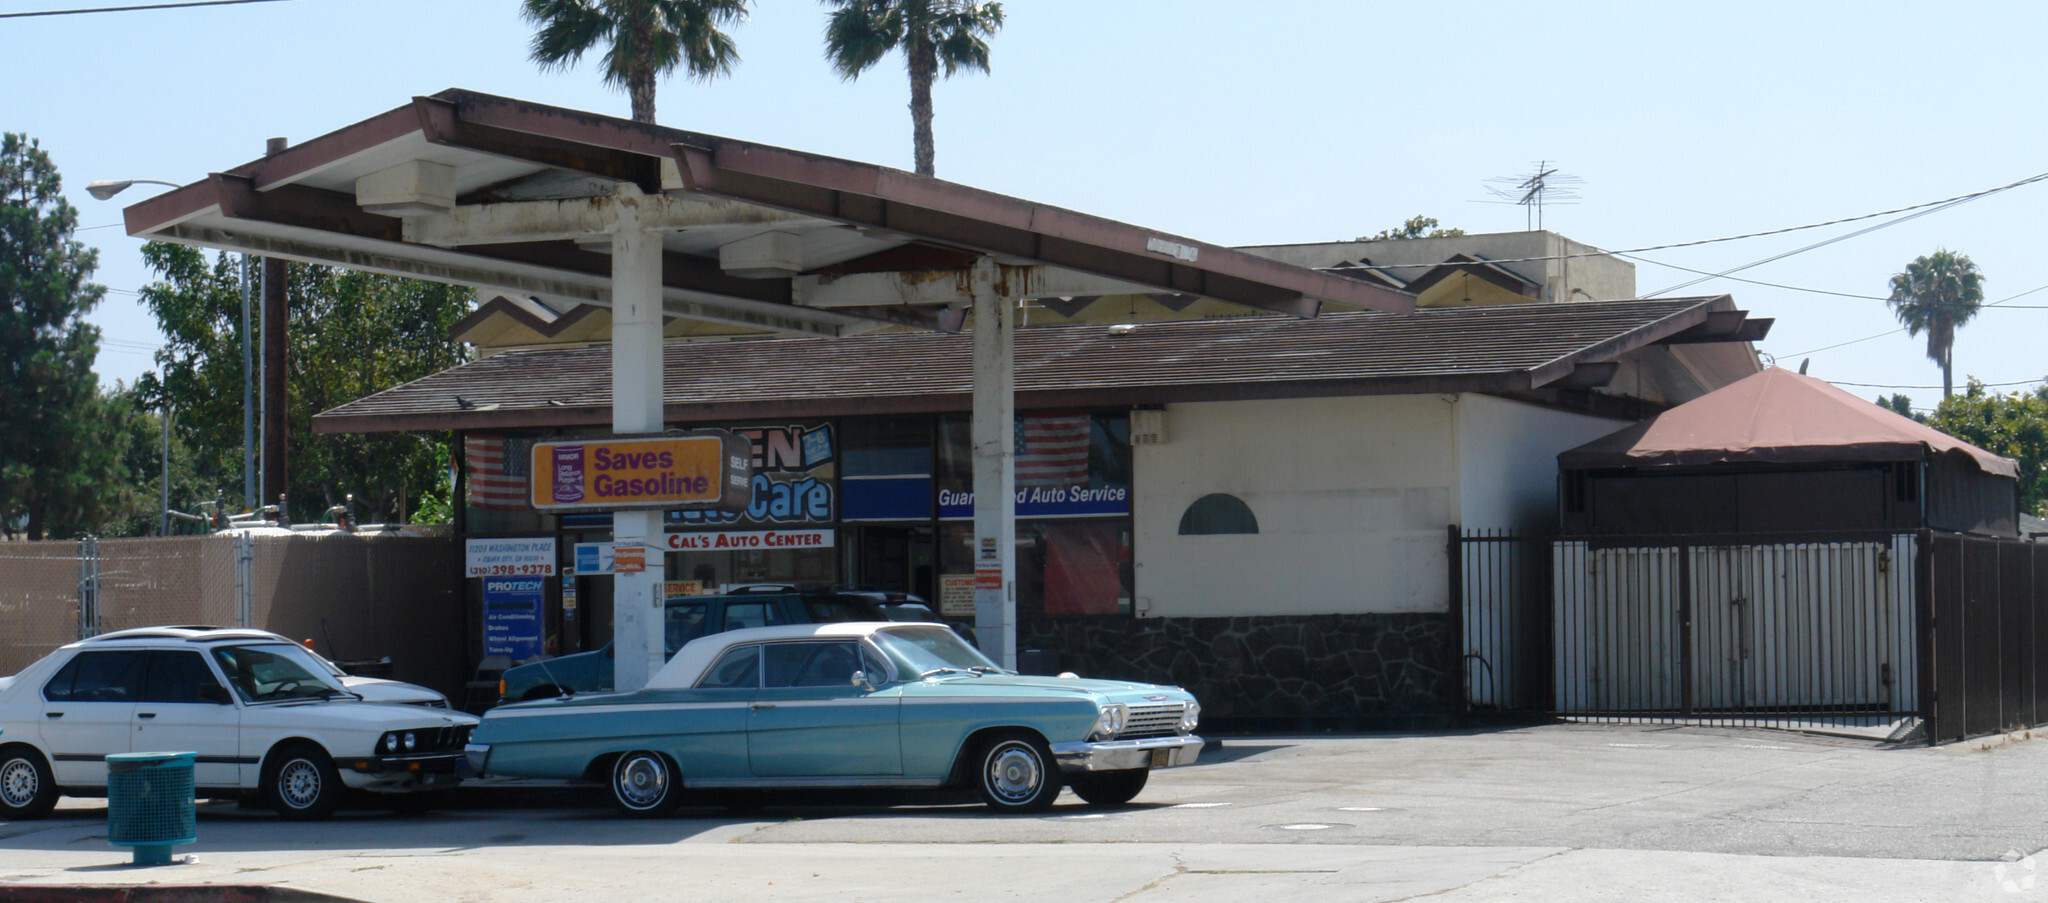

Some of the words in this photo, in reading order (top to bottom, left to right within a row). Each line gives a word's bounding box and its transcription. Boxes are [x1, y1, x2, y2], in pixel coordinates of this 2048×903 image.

[594, 447, 674, 471] Saves
[730, 456, 749, 470] SELF
[594, 472, 709, 497] Gasoline
[749, 474, 829, 519] Care
[1029, 486, 1066, 504] Auto
[1069, 484, 1126, 503] Service
[488, 543, 530, 553] WASHINGTON
[531, 542, 552, 552] PLACE
[470, 566, 491, 575] (310)
[487, 581, 543, 591] PROTECH
[508, 635, 538, 643] Alignment
